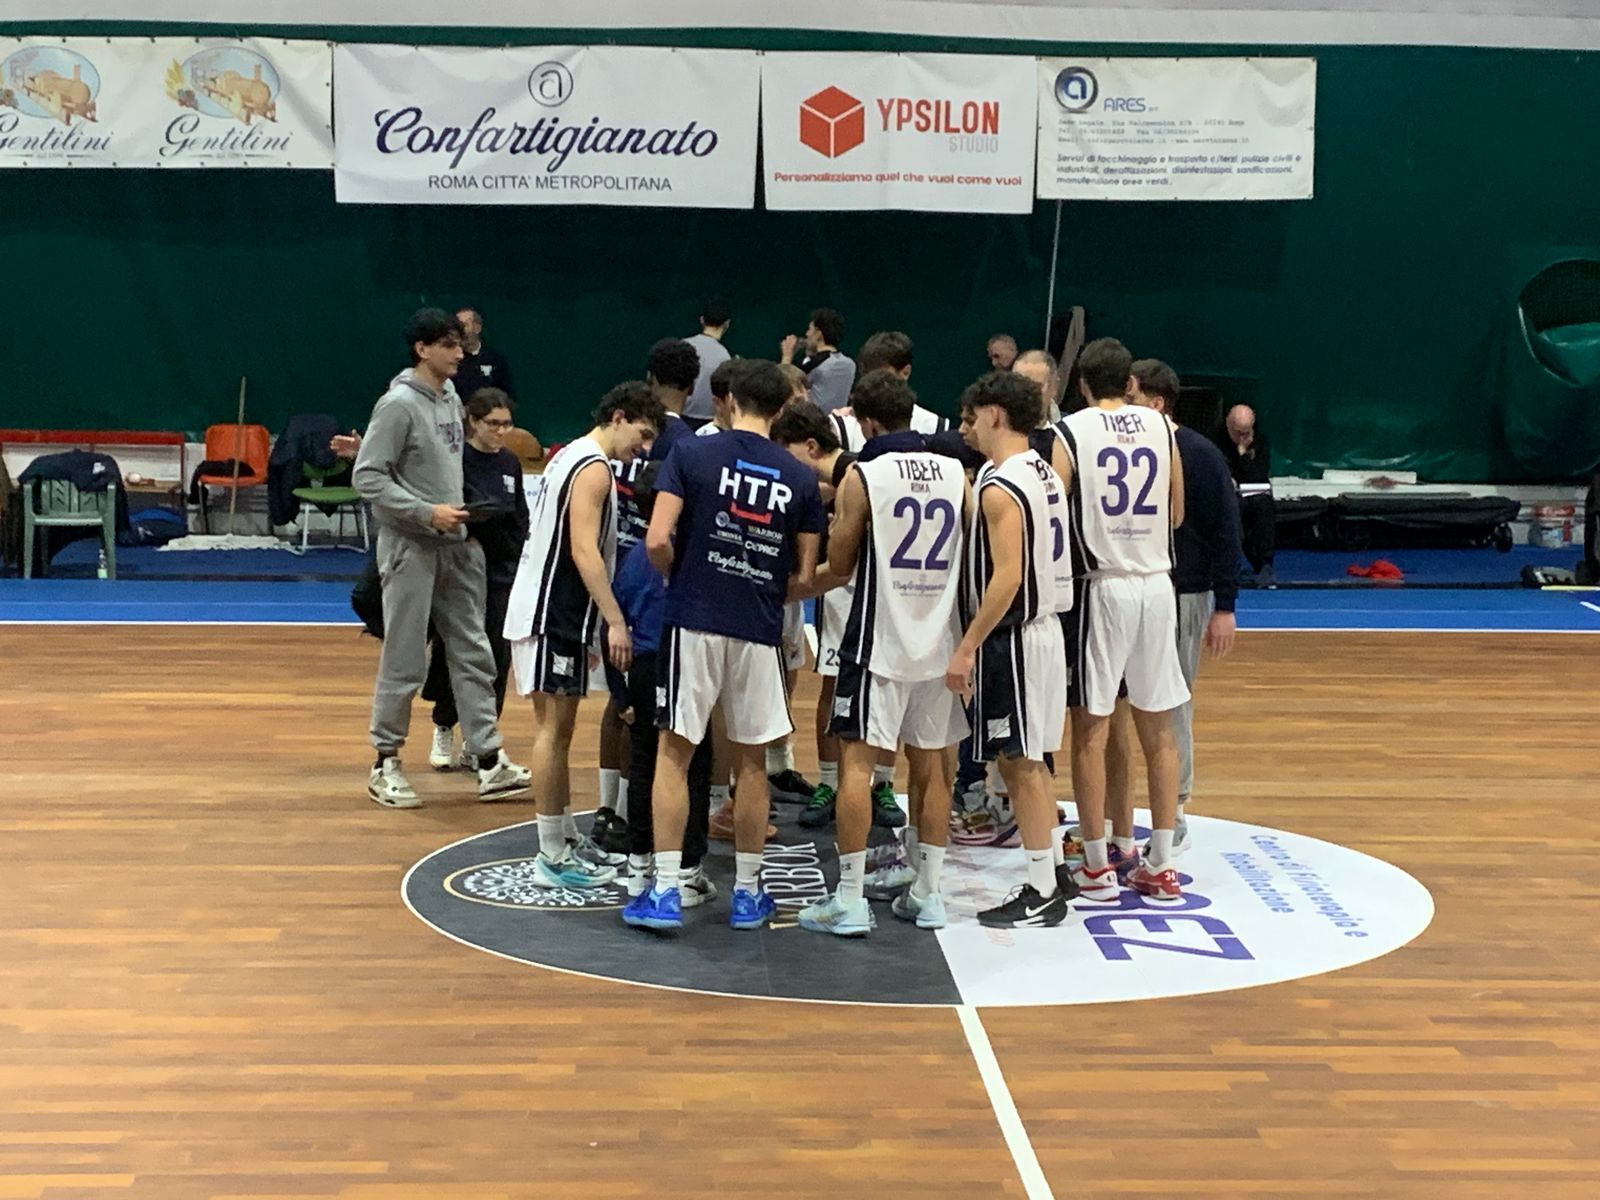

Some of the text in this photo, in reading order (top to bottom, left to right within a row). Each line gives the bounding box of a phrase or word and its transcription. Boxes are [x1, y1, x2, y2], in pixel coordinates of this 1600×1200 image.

[1104, 97, 1146, 113] ARES
[876, 98, 1000, 135] YPSILON
[159, 113, 293, 157] Gentilini
[374, 106, 719, 173] Confartigianato
[949, 135, 999, 153] STUDIO
[1087, 154, 1096, 163] di
[1097, 154, 1158, 165] facchinaggio
[1168, 154, 1208, 165] trasporto
[1241, 154, 1270, 164] pulizie
[1272, 154, 1293, 163] civili
[428, 175, 672, 191] ROMA CITTA' METROPOLITANA
[774, 172, 1022, 186] Personalizziamo quel che vuoi come vuoi
[894, 459, 944, 481] TIBER
[718, 466, 793, 514] HTR
[1097, 446, 1158, 517] 32
[889, 496, 956, 571] 22
[825, 647, 841, 667] 2
